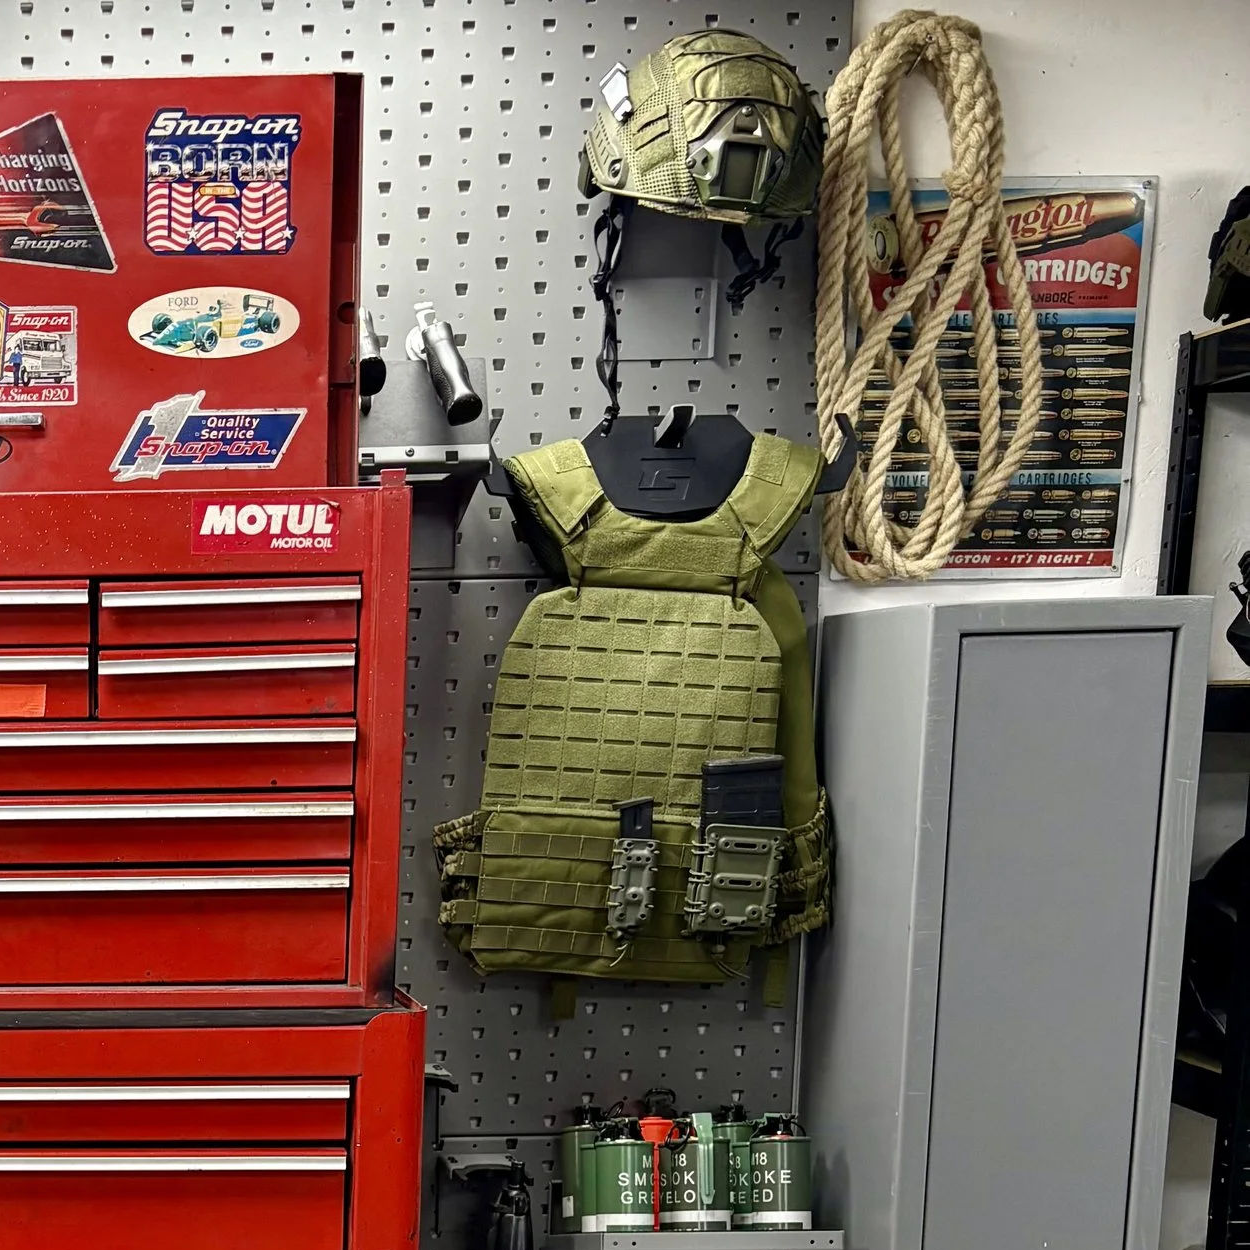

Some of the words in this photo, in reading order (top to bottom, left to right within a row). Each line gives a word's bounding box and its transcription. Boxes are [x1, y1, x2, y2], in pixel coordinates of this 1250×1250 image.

[148, 112, 299, 142] Snap-on
[147, 143, 289, 182] BORN
[147, 182, 288, 251] USA
[921, 199, 1096, 250] Rngton
[10, 236, 91, 252] Snap-on
[997, 259, 1132, 290] RTRIDGES
[168, 296, 199, 308] FORD
[10, 313, 70, 328] Snap-on
[8, 388, 39, 402] Since
[41, 387, 69, 402] 1920
[206, 416, 260, 430] Quality
[200, 427, 255, 440] Service
[135, 436, 271, 463] Snap-on
[1018, 472, 1093, 486] CARTRIDGES
[199, 503, 334, 535] MOTUL
[270, 537, 313, 549] MOTOR
[313, 537, 333, 549] OIL
[1010, 554, 1033, 564] IT'S
[1037, 554, 1087, 564] RIGHT
